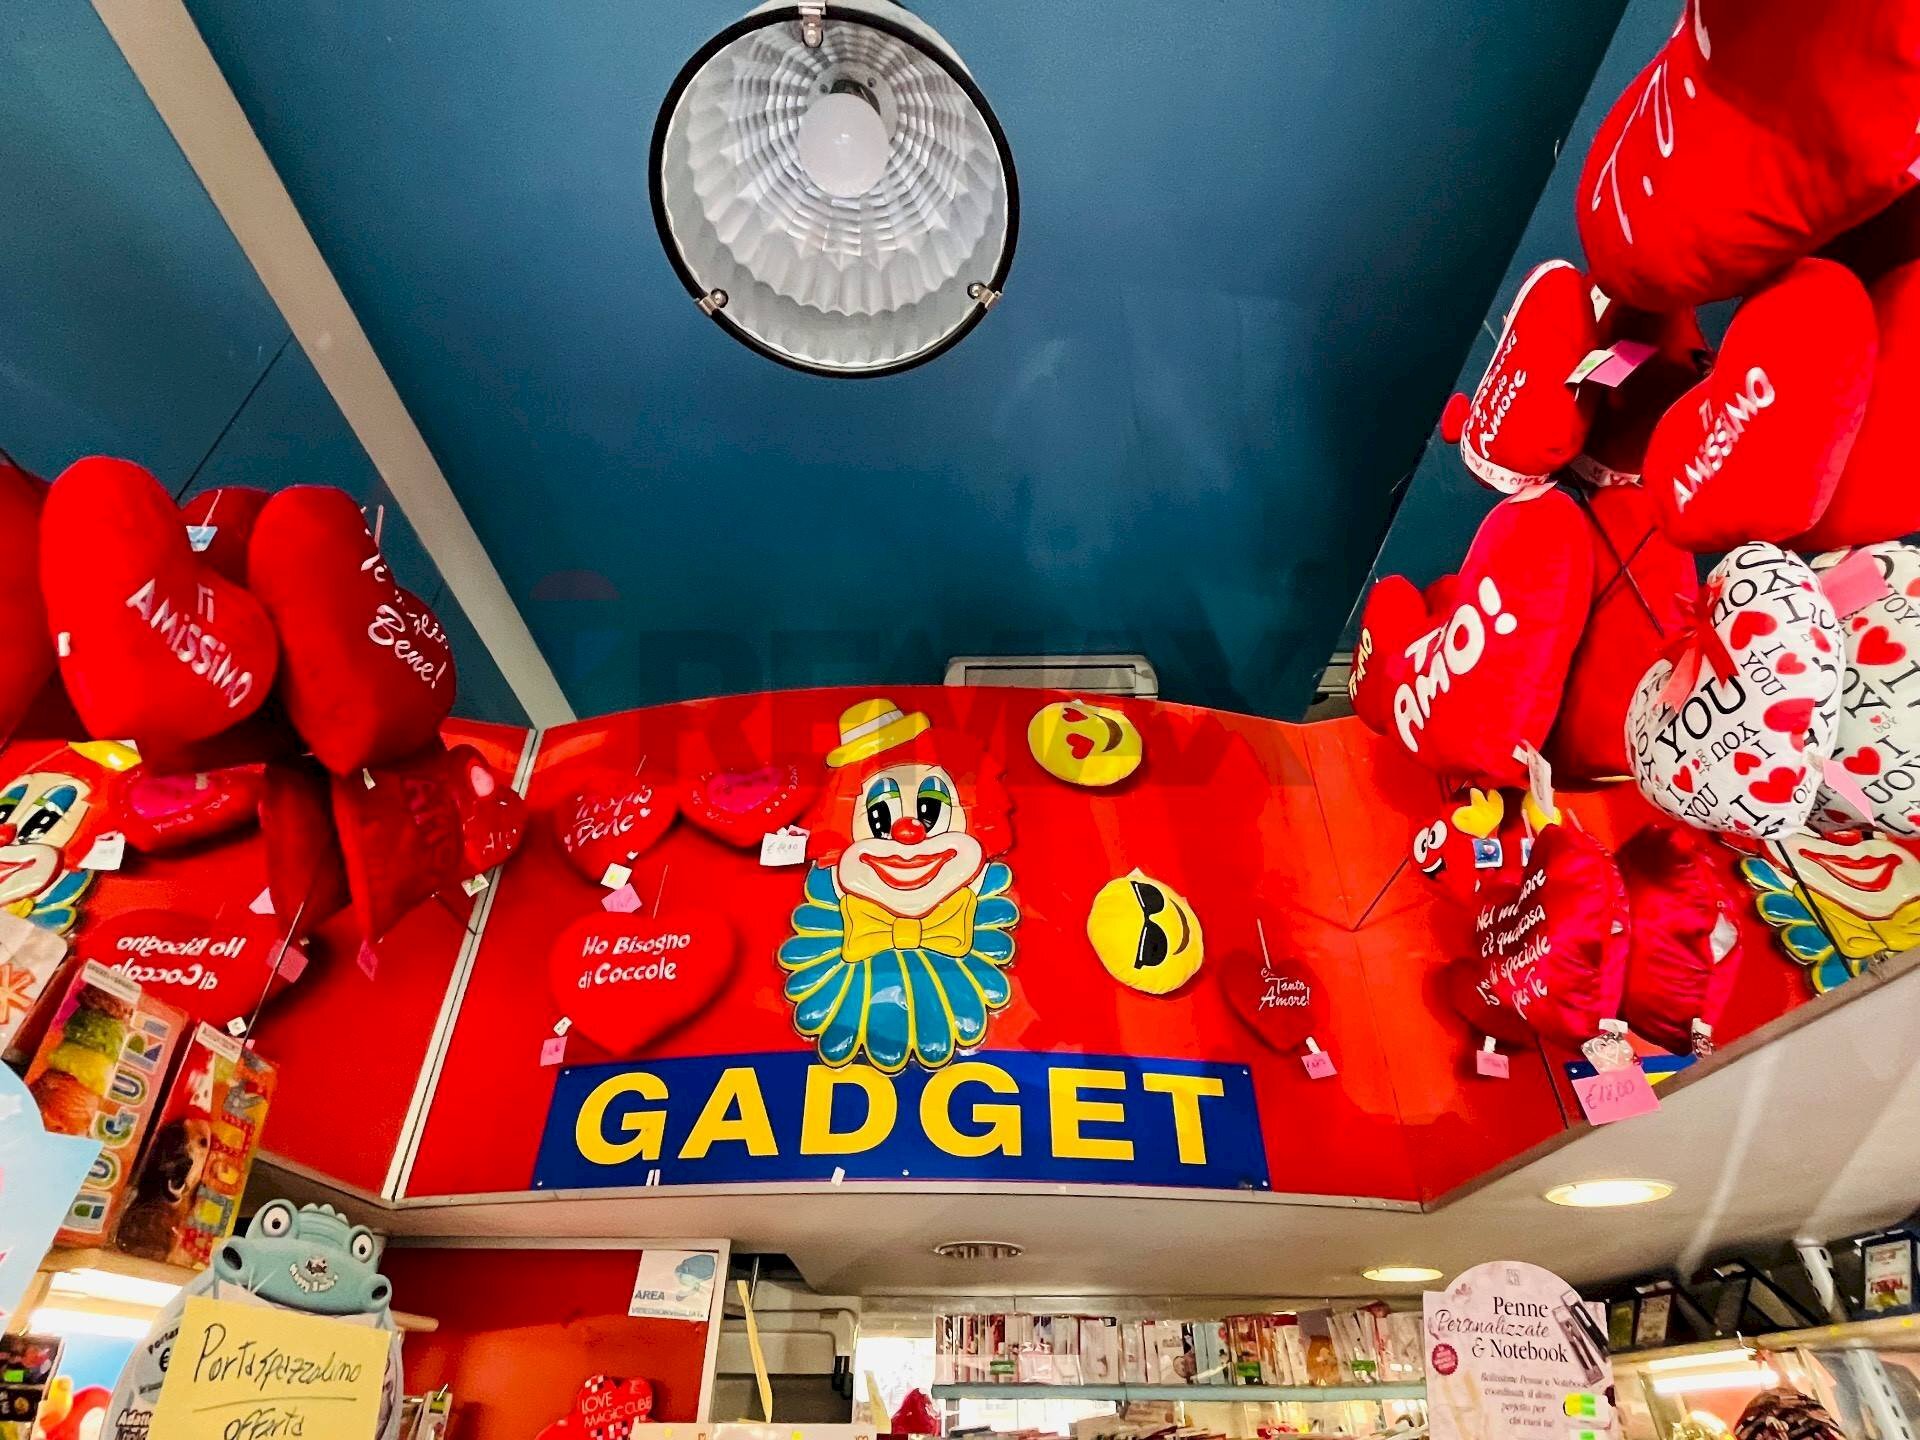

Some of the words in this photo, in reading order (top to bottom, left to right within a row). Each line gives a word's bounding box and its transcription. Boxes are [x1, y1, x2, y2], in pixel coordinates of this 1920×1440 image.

[367, 604, 447, 690] Bene!
[1740, 650, 1788, 696] YOU
[1655, 674, 1747, 764] YOU
[1711, 720, 1761, 763] YOU
[1683, 782, 1719, 823] YOU
[581, 935, 609, 958] Ho
[612, 933, 691, 956] Bisogno
[577, 971, 592, 989] di
[594, 957, 677, 986] Coccole
[1258, 986, 1310, 1011] Amore!
[575, 1065, 1225, 1165] GADGET
[634, 1289, 665, 1301] AREA
[1493, 1296, 1549, 1318] Penne
[1434, 1309, 1550, 1338] Personalizzate
[1471, 1337, 1485, 1358] &
[1490, 1338, 1569, 1363] Notebook
[581, 1391, 613, 1414] LOVE
